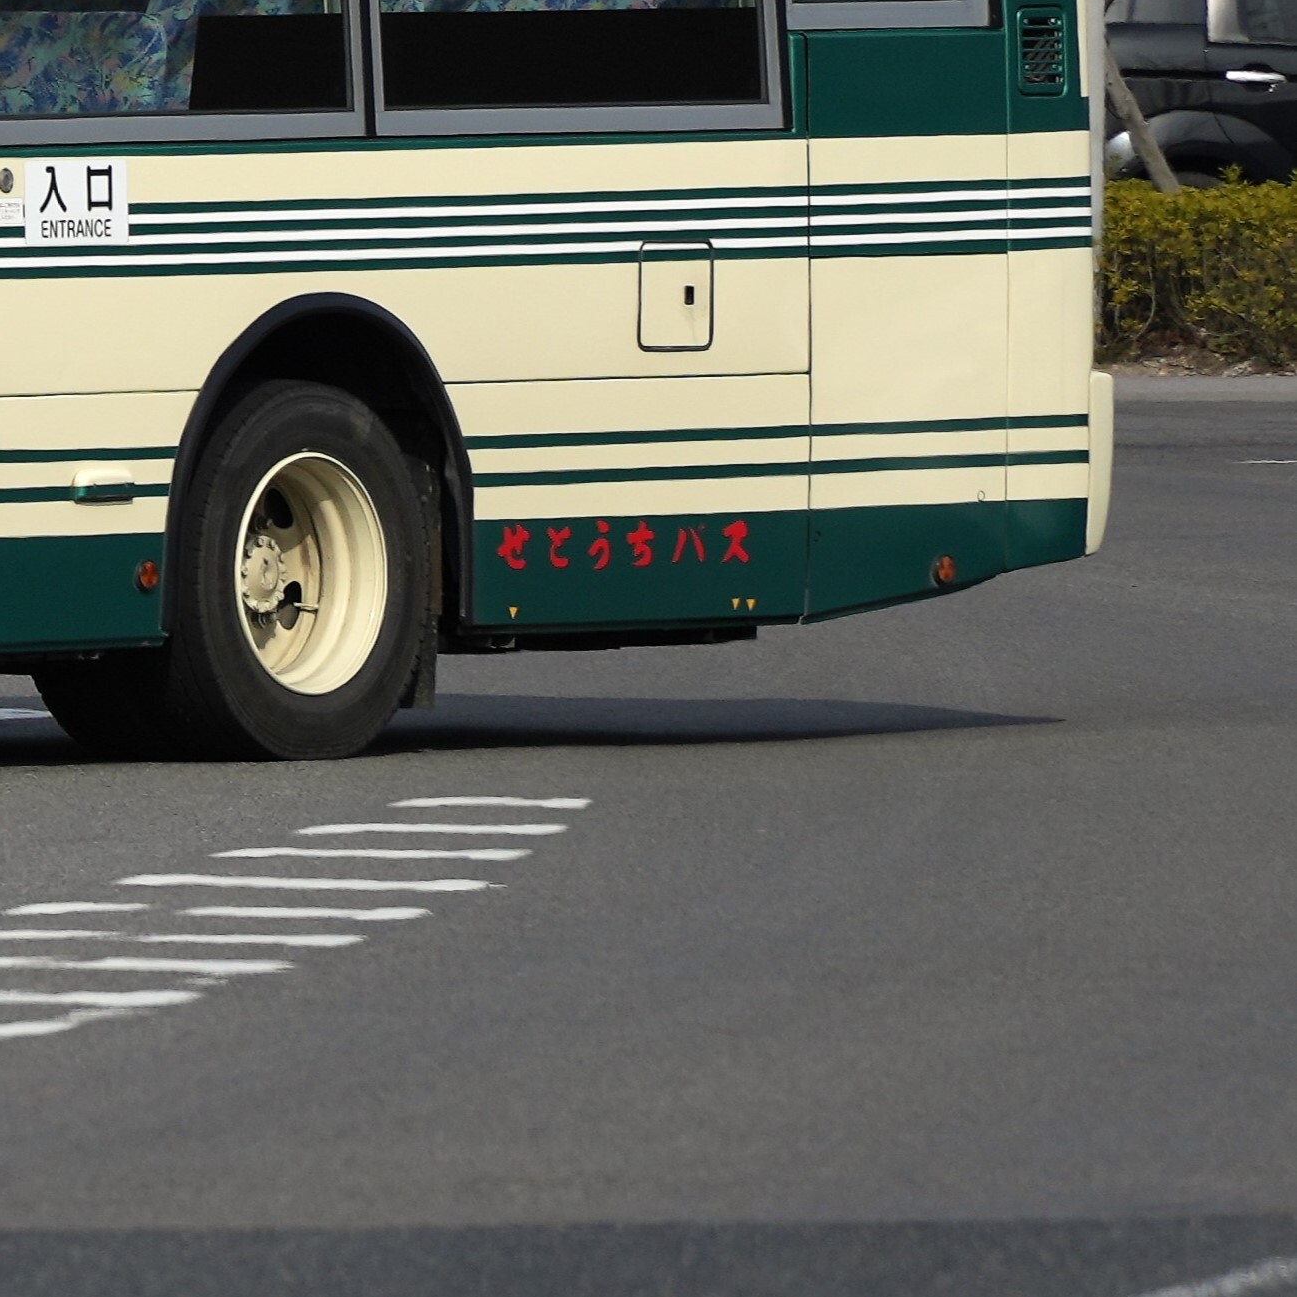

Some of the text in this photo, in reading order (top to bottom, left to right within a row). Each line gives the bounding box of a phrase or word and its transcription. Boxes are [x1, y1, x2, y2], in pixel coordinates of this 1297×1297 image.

[39, 164, 113, 214] 入口
[40, 218, 113, 239] ENTRANCE
[496, 519, 750, 571] せとうちバス
